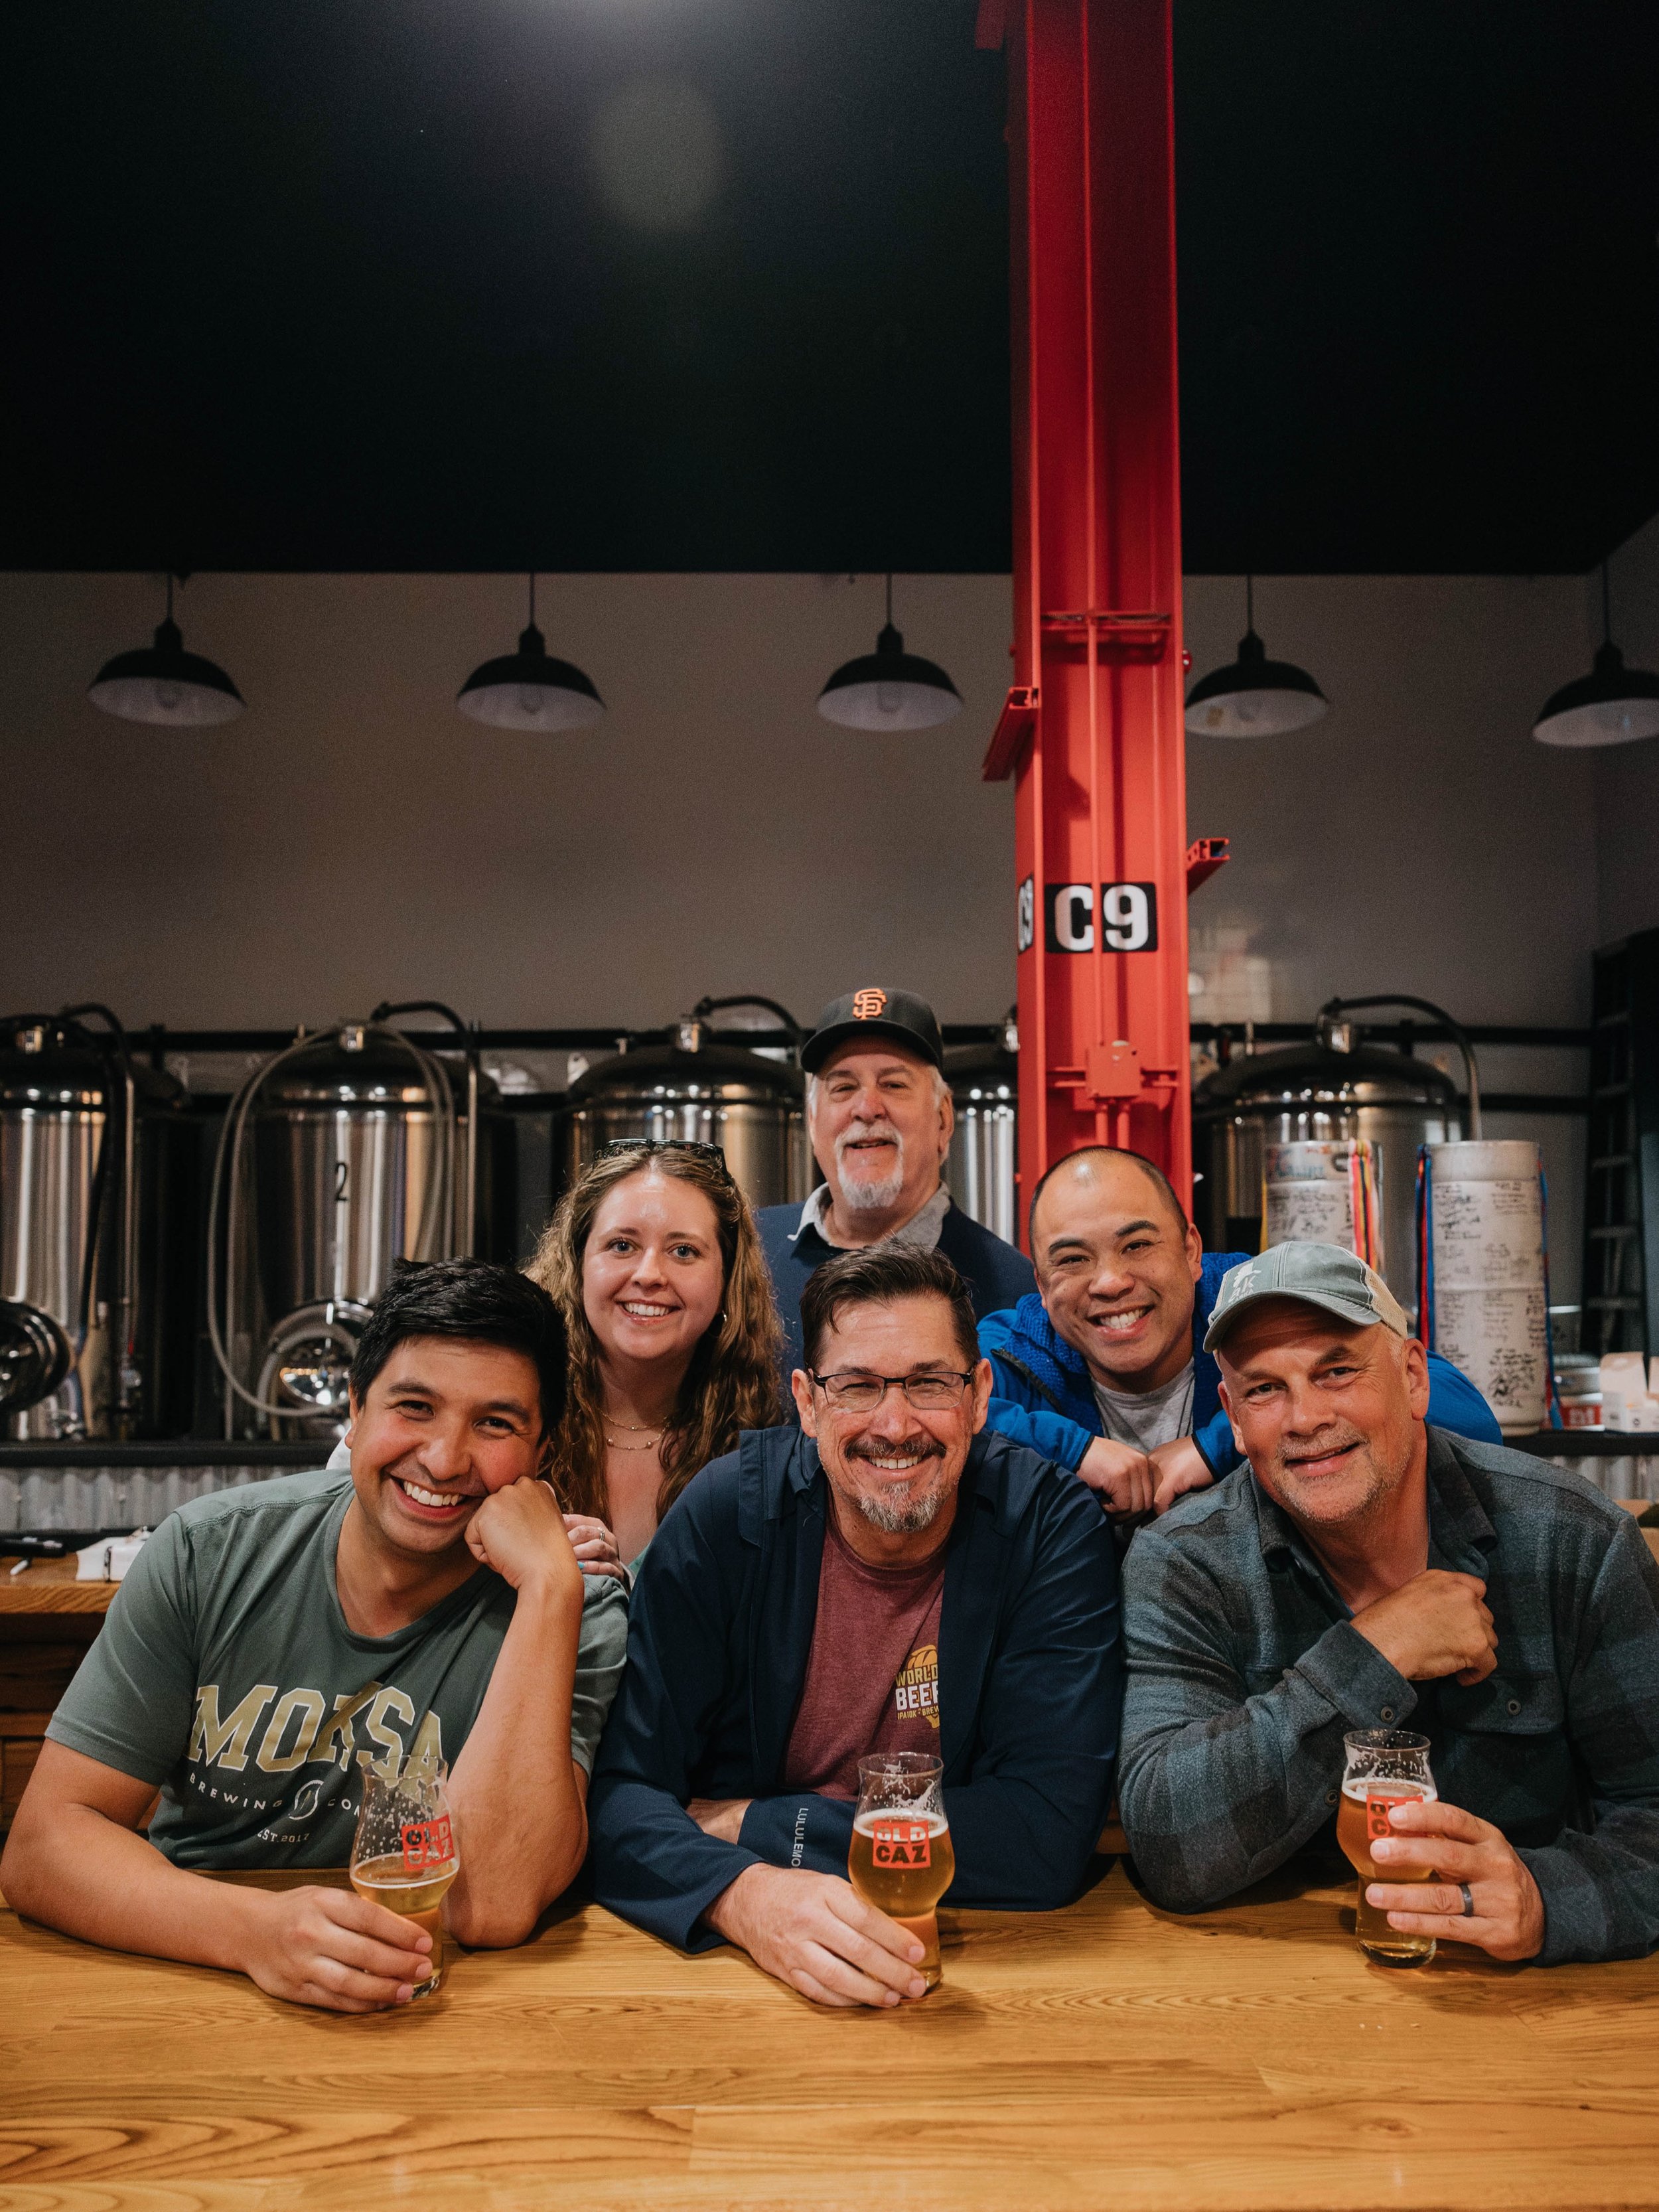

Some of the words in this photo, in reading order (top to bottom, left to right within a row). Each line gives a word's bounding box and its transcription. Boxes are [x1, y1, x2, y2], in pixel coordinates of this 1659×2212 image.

[1054, 885, 1149, 951] C9
[853, 988, 887, 1020] SF
[334, 1163, 348, 1201] 2
[896, 1664, 938, 1686] WORLD
[186, 1681, 445, 1789] MOKSA
[189, 1773, 283, 1810] BREWING
[406, 1821, 450, 1846] OLD
[877, 1826, 926, 1844] OLD
[407, 1838, 453, 1866] CAZ
[877, 1844, 927, 1864] CAZ
